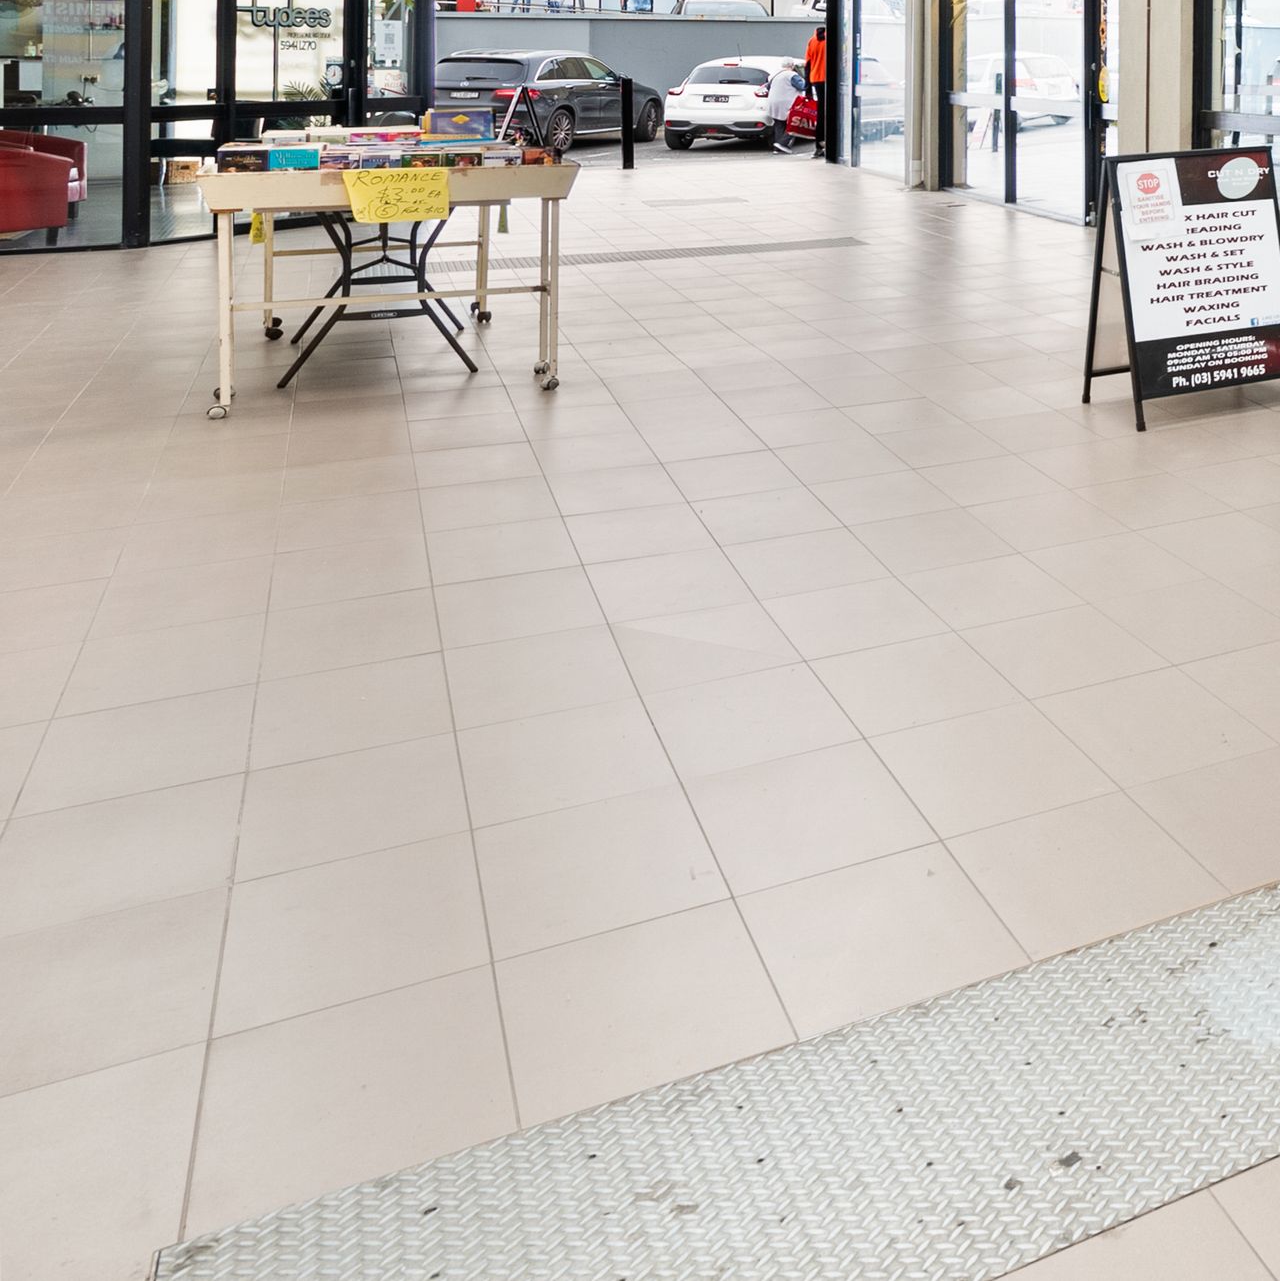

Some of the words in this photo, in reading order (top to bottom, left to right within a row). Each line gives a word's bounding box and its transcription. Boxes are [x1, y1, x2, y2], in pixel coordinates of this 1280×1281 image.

[237, 5, 332, 28] tydees
[790, 115, 817, 131] SAL
[352, 170, 444, 187] ROMANCE
[1137, 176, 1161, 190] STOP
[1195, 212, 1229, 221] HAIR
[1232, 209, 1257, 218] CUT
[1140, 241, 1183, 252] WASH
[1187, 240, 1196, 248] &
[1199, 234, 1265, 246] BLOWDRY
[1165, 252, 1207, 263] WASH
[1223, 248, 1246, 257] SET
[1159, 266, 1201, 276] WASH
[1204, 264, 1213, 272] &
[1216, 260, 1254, 271] STYLE
[1156, 279, 1190, 290] HAIR
[1194, 272, 1260, 286] BRAIDING
[1150, 294, 1185, 305] HAIR
[1188, 284, 1268, 300] TREATMENT
[1183, 300, 1240, 314] WAXING
[1185, 314, 1241, 327] FACIALS
[1167, 348, 1211, 359] MONDAY
[1216, 340, 1266, 352] SATURDAY
[1176, 340, 1220, 351] OPENING
[1221, 335, 1256, 345] HOURS:
[1166, 357, 1194, 366] 09:00
[1194, 354, 1211, 363] AM
[1212, 352, 1226, 360] TO
[1226, 349, 1252, 357] 05:00
[1253, 346, 1267, 354] PM
[1166, 362, 1207, 373] SUNDAY
[1207, 359, 1223, 367] ON
[1224, 353, 1269, 364] BOOKING
[1172, 375, 1190, 388] Ph.
[1191, 371, 1212, 387] (03)
[1213, 368, 1238, 382] 5941
[1241, 364, 1266, 378] 9665
